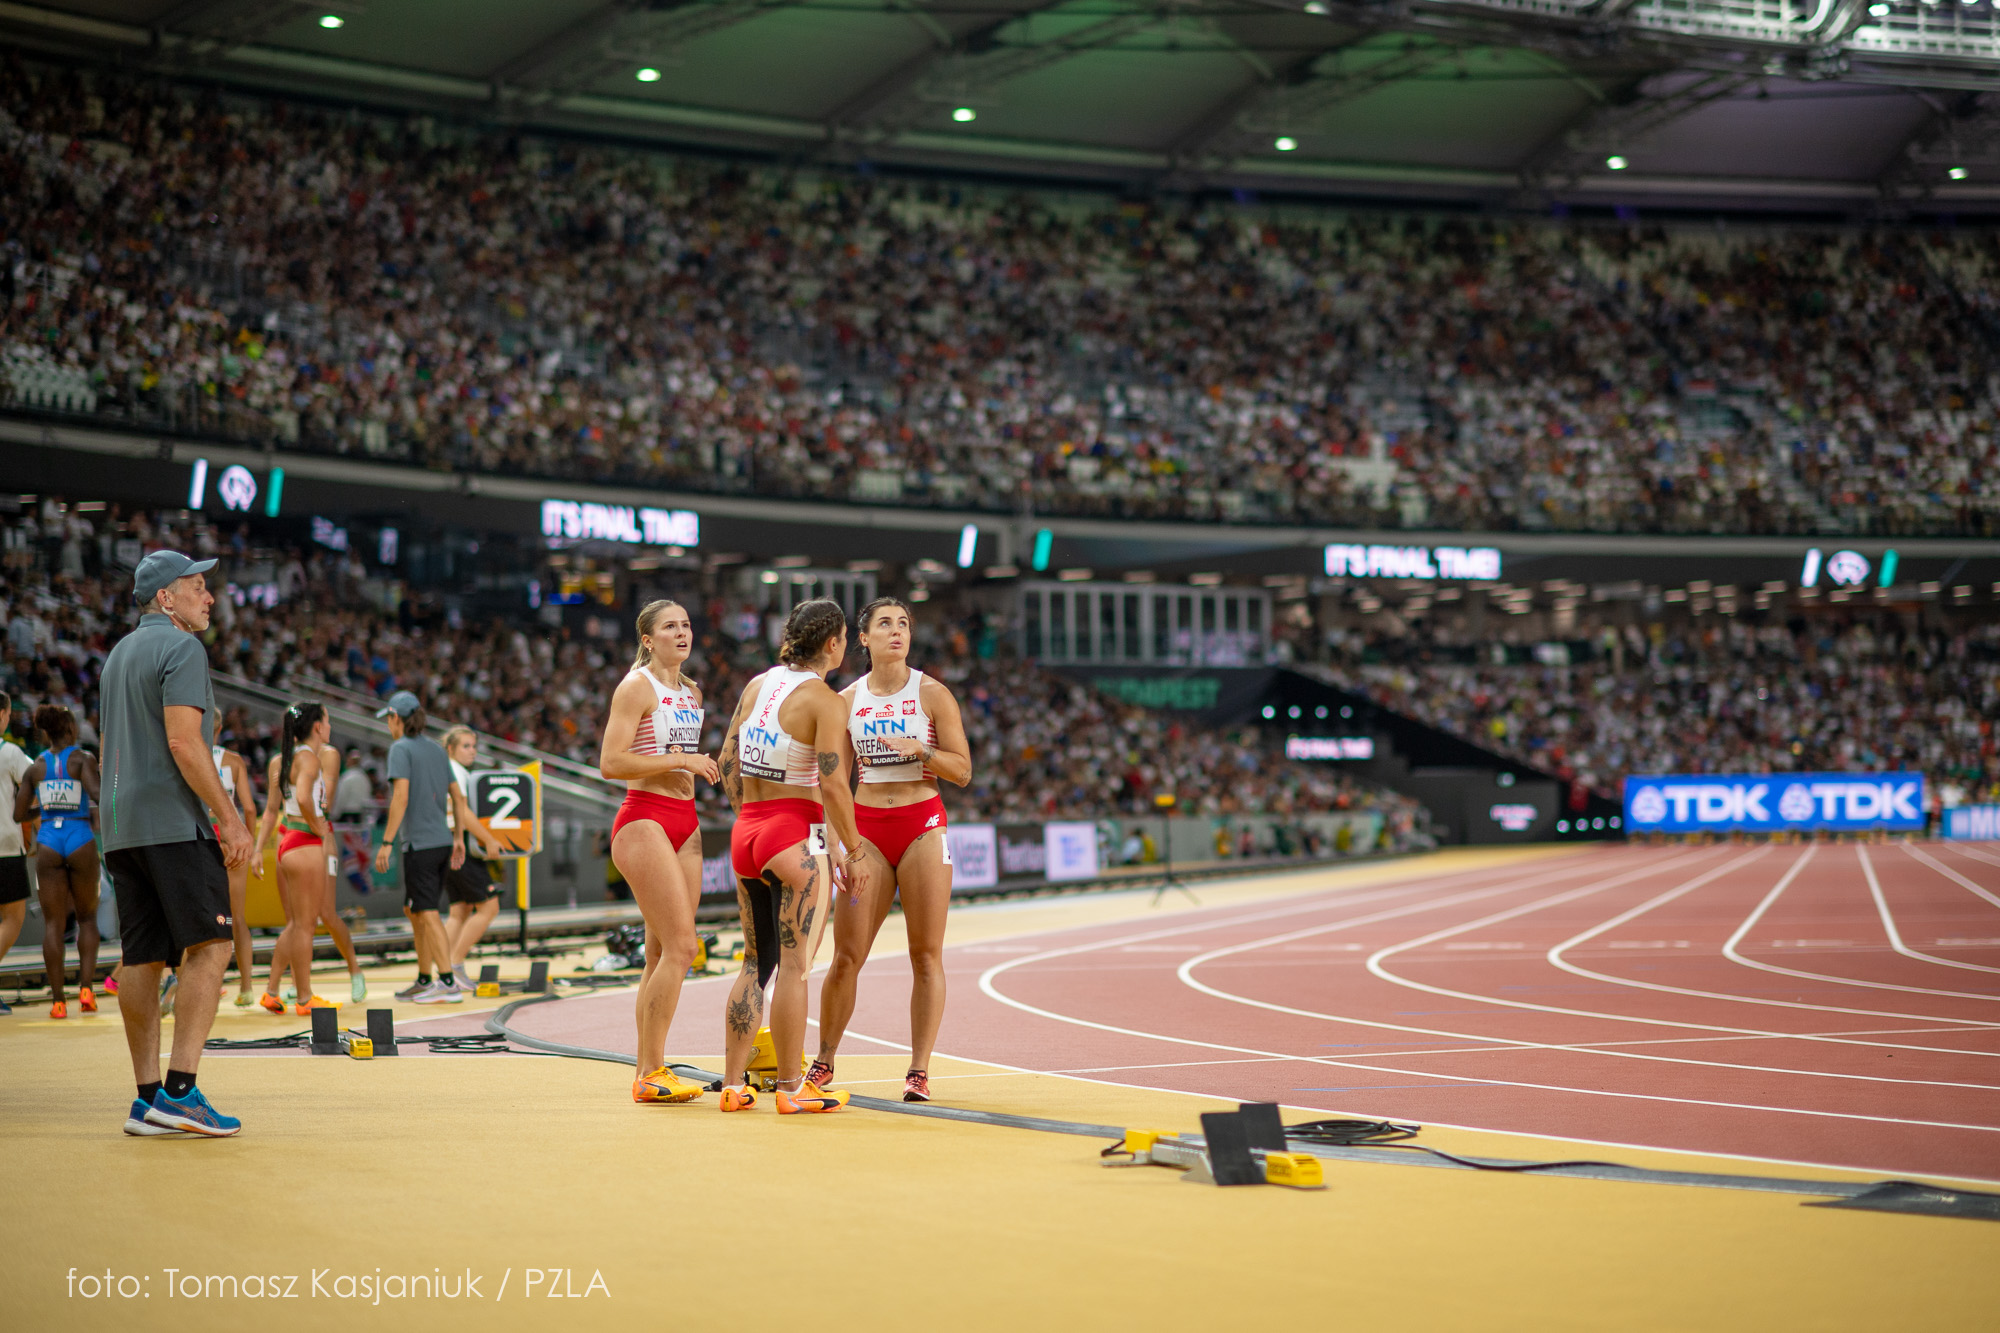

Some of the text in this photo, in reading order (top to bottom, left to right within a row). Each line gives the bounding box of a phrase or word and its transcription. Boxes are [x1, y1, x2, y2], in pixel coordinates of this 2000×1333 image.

[581, 502, 641, 542] FINAL
[1367, 545, 1436, 578] FINAL
[759, 681, 786, 728] POLSKA
[673, 710, 700, 724] NTN
[863, 718, 906, 736] NTN
[746, 726, 779, 748] NTN
[743, 745, 770, 766] POL
[872, 755, 908, 764] BUDAPEST
[742, 764, 783, 779] BUDAPEST 23
[46, 782, 74, 791] NTN
[50, 791, 68, 802] ITA
[488, 786, 522, 830] 2
[1662, 783, 1770, 823] TDK
[1810, 781, 1918, 821] TDK
[816, 828, 826, 849] 5
